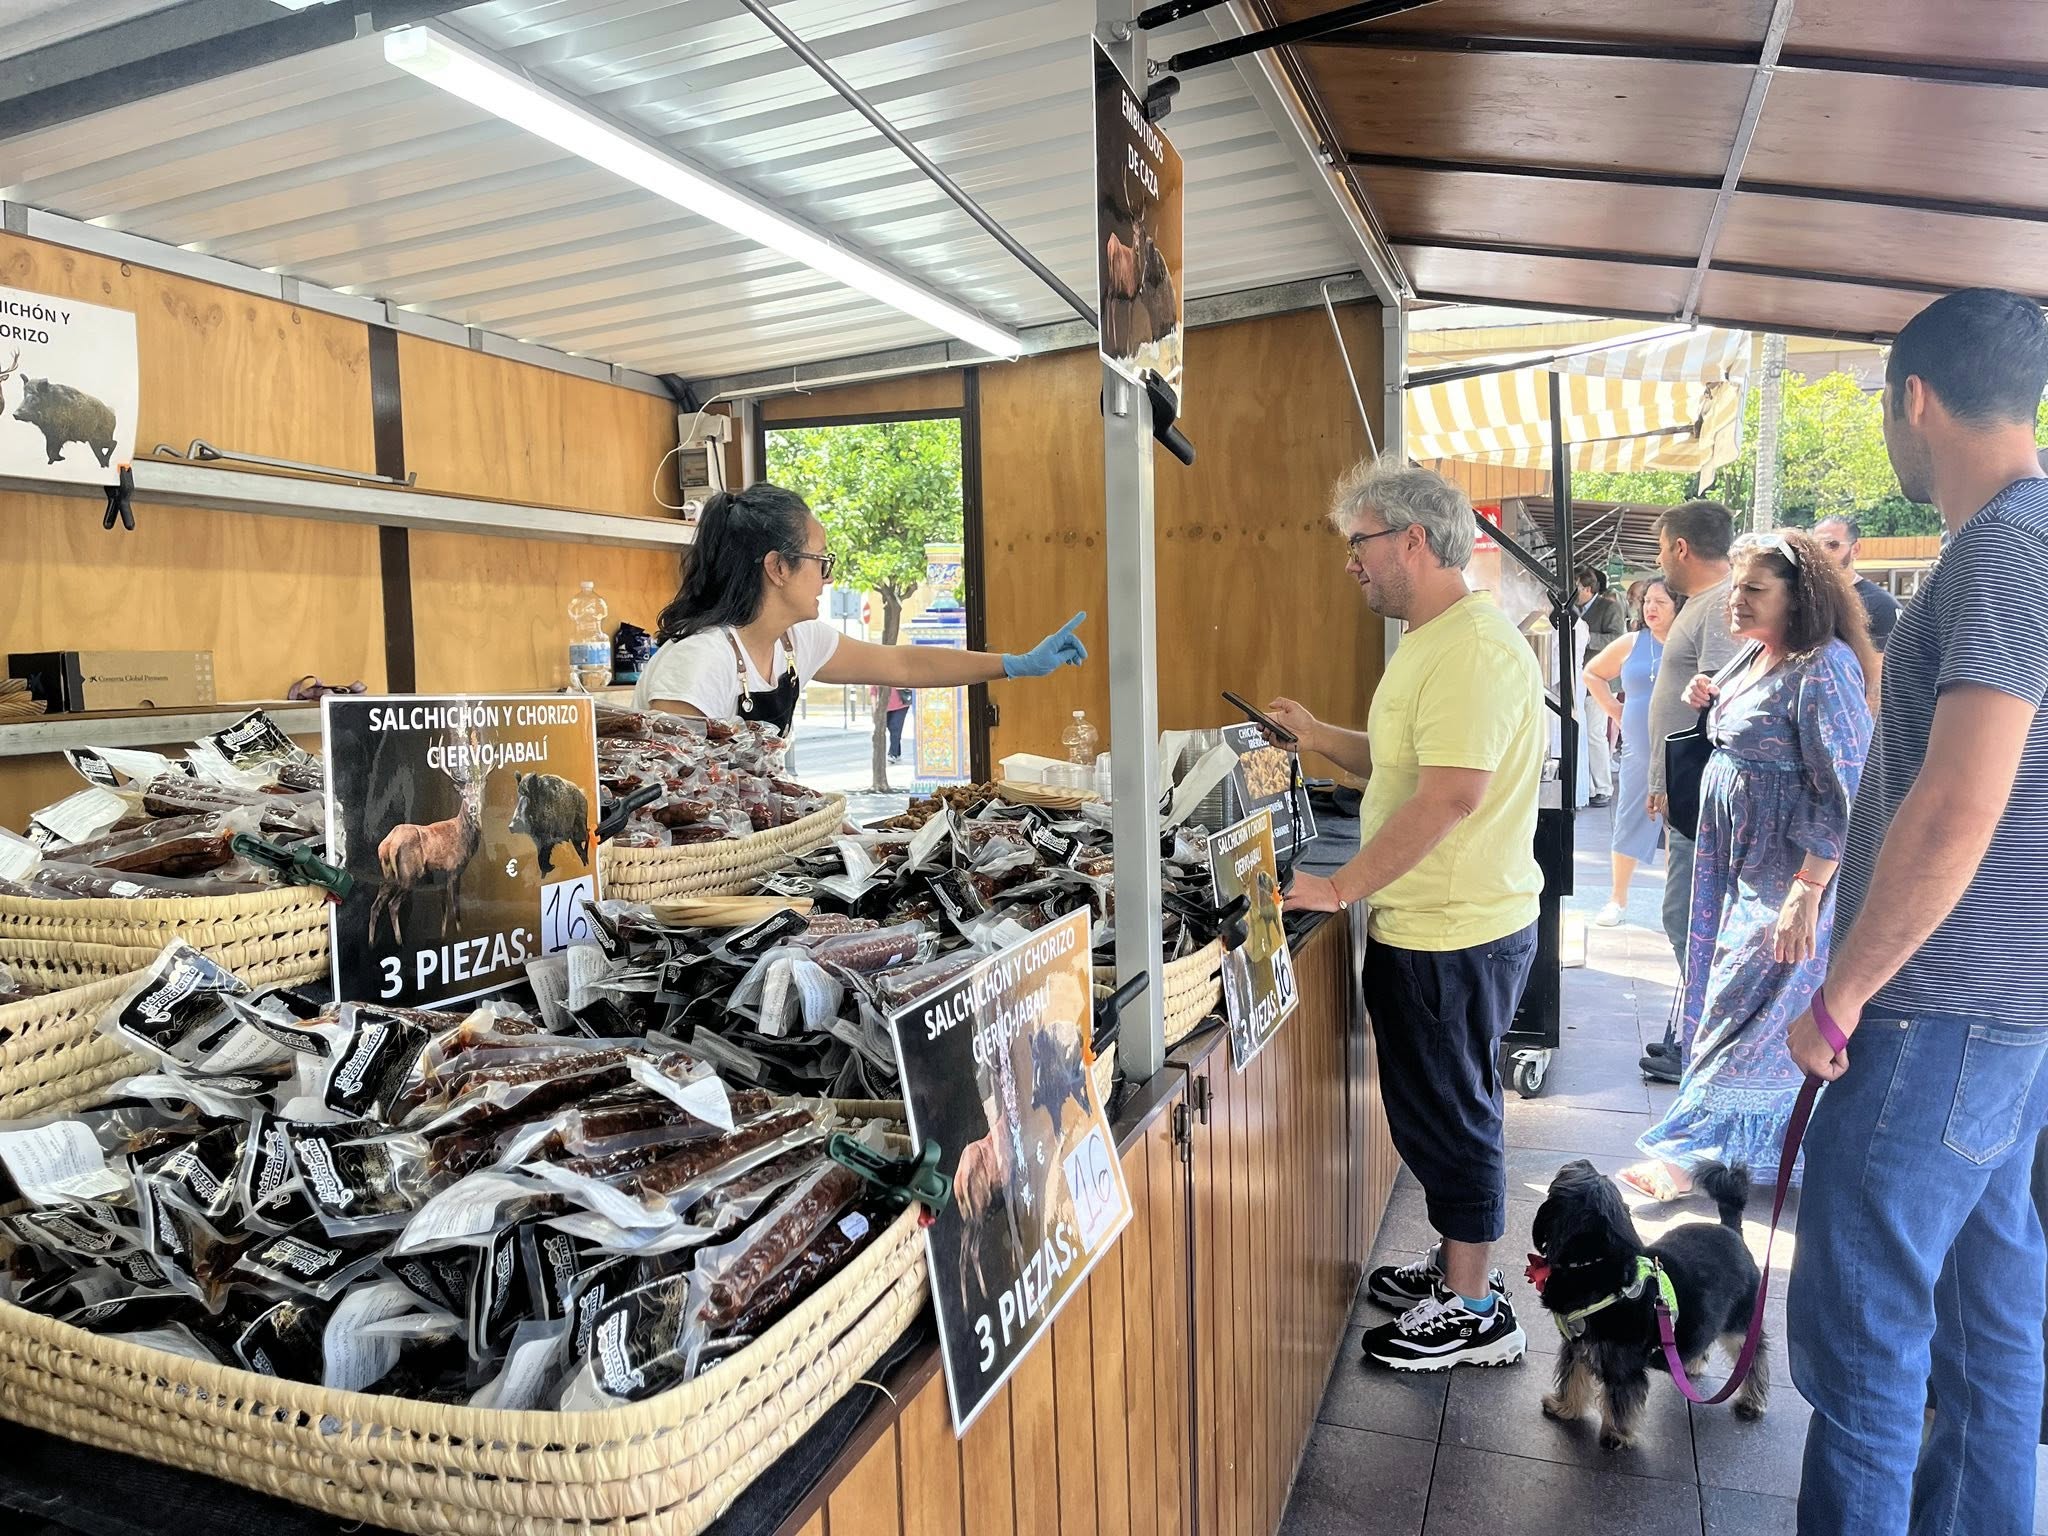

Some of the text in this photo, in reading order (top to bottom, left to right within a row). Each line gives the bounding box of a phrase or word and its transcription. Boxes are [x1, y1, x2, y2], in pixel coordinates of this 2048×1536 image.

[1122, 89, 1164, 164] EMBUTIDOS
[1128, 143, 1159, 200] DE CAZA
[61, 312, 70, 325] Y
[369, 701, 578, 731] SALCHICHÓN Y CHORIZO
[427, 735, 548, 768] CIERVO-JABALÍ
[506, 858, 517, 877] €
[546, 883, 587, 952] 16
[380, 956, 402, 998] 3
[417, 928, 533, 990] PIEZAS:
[925, 927, 1075, 1040] SALCHICHÓN Y CHORIZO
[1275, 948, 1292, 1007] 16
[1075, 1133, 1111, 1234] 16
[974, 1221, 1078, 1373] 3 PIEZAS:
